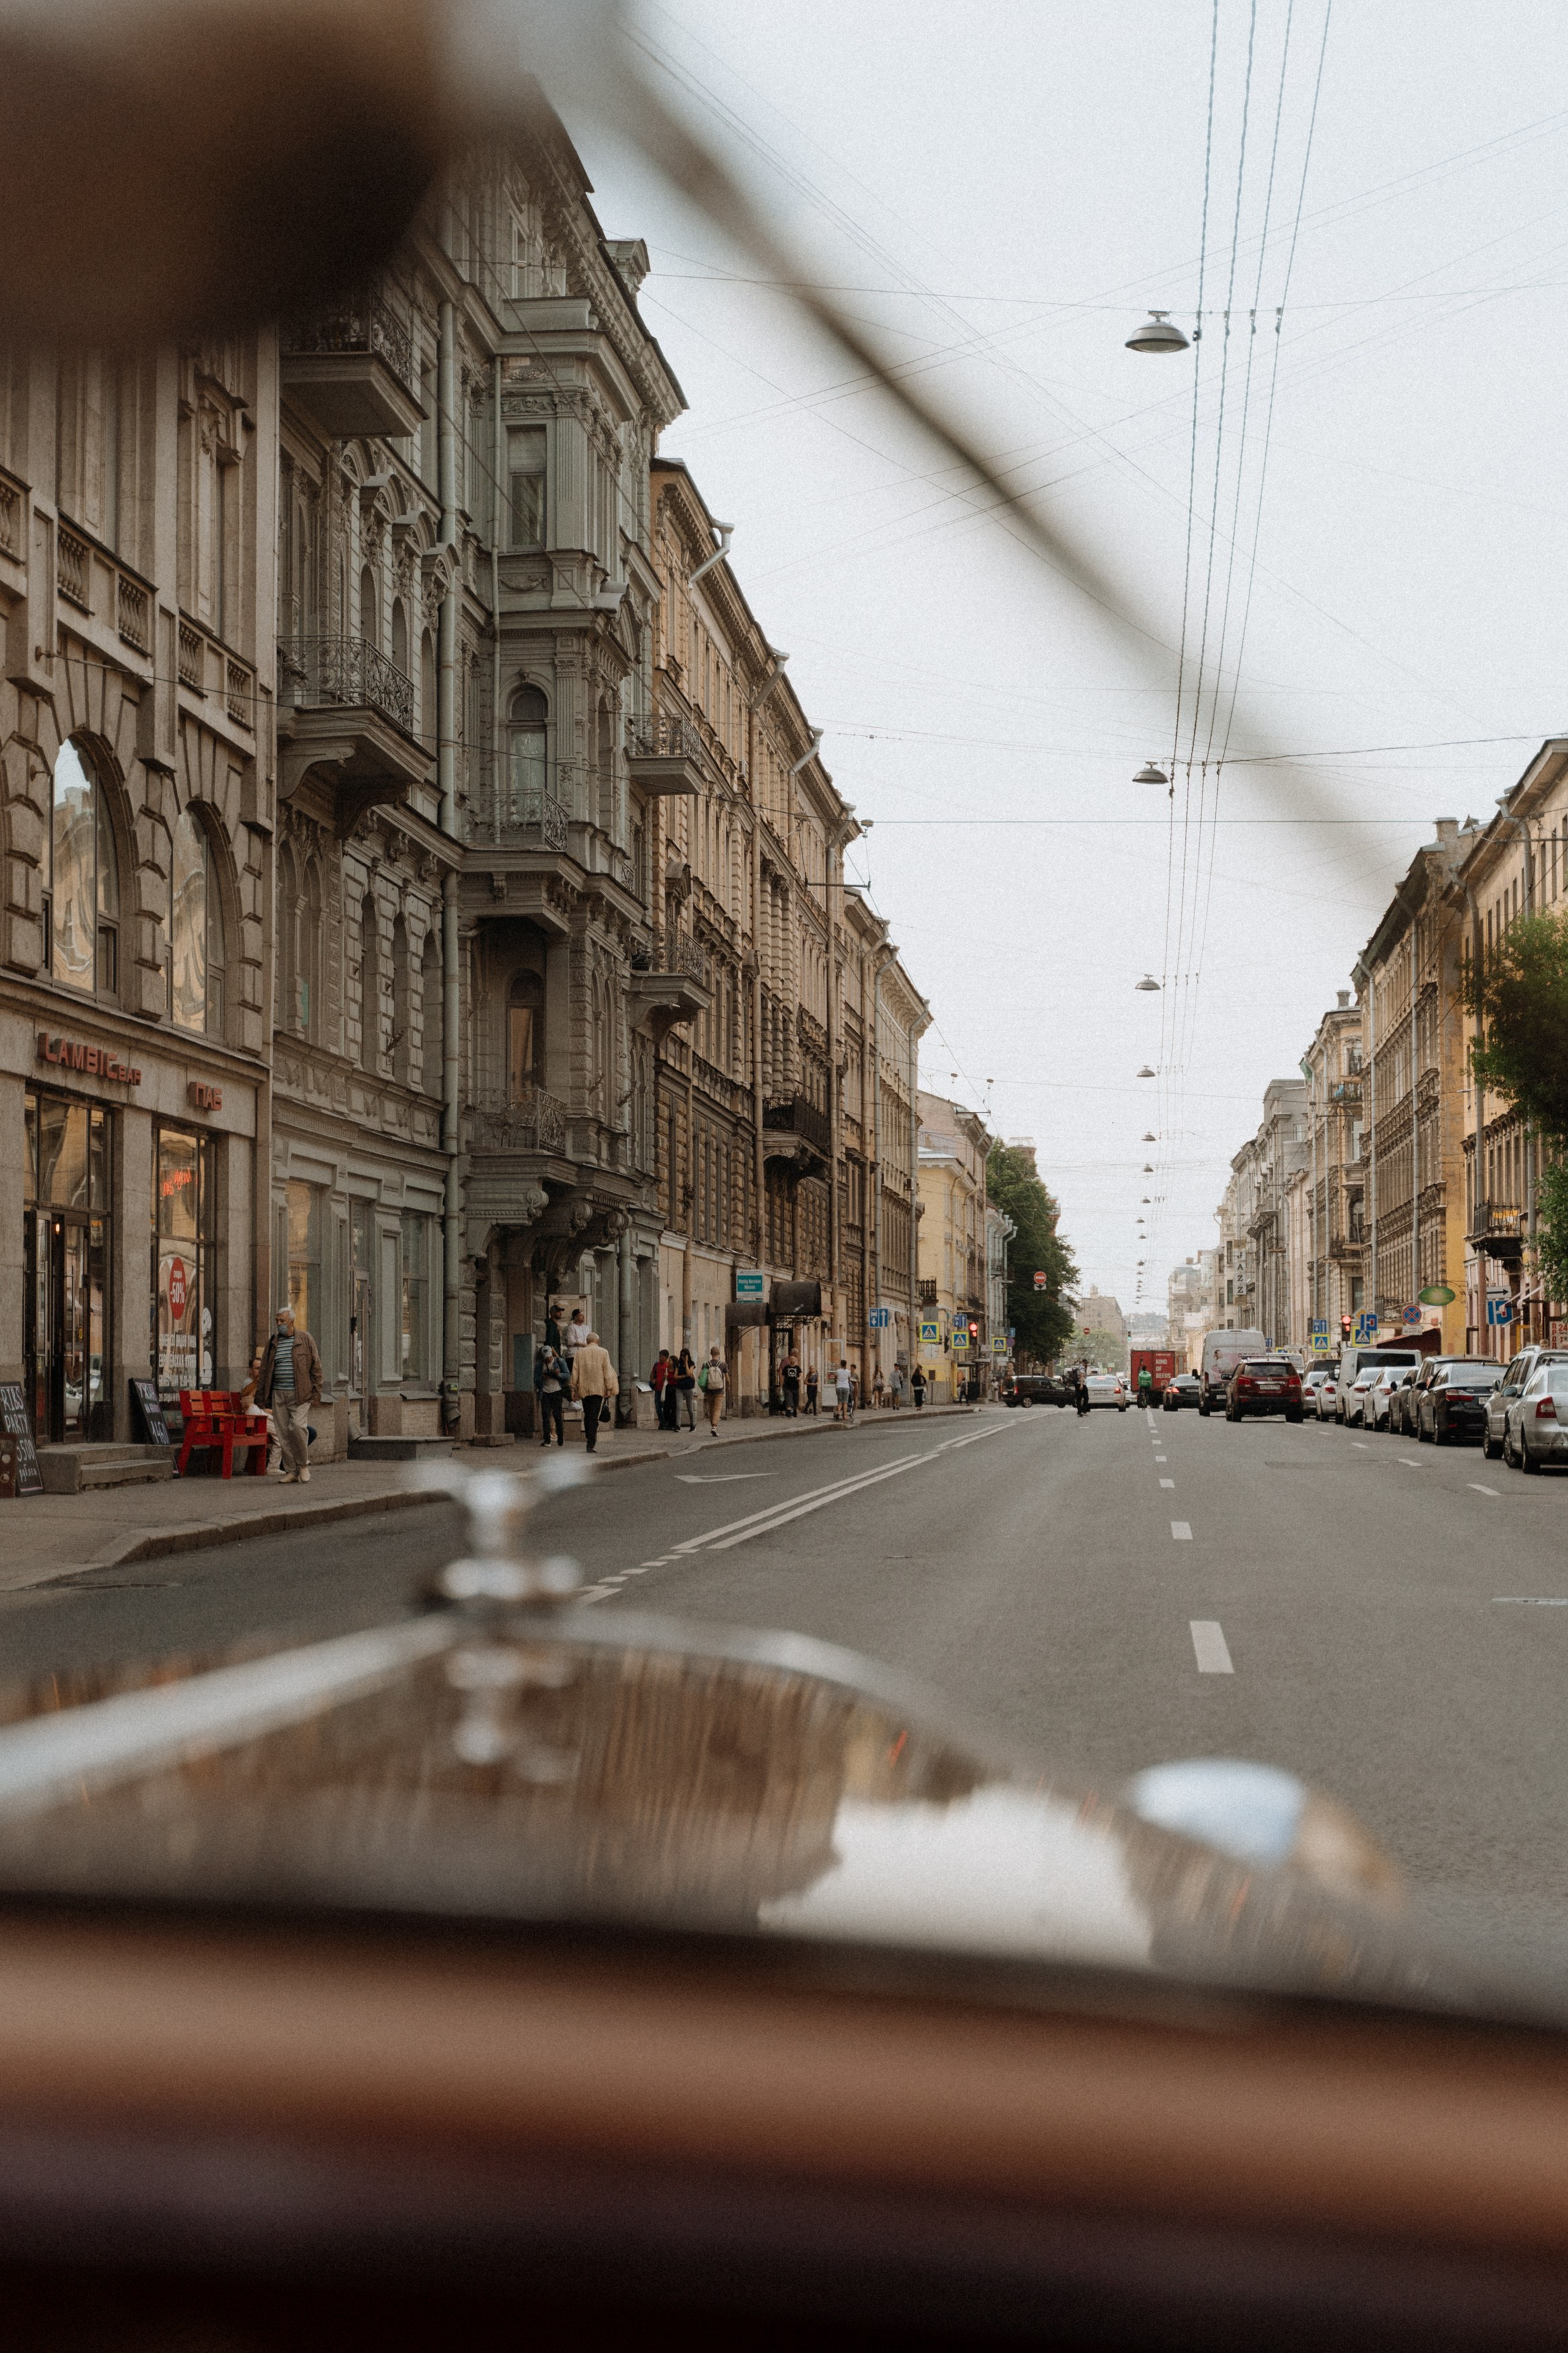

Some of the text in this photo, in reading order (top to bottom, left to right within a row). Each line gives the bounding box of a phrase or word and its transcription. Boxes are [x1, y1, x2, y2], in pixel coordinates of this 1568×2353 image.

[38, 1033, 118, 1080] LAMBIC
[189, 1081, 222, 1111] ПАБ
[170, 1281, 185, 1304] -50%
[1559, 1323, 1568, 1332] 24
[1, 1387, 24, 1411] RIBS
[4, 1414, 28, 1434] PARTY
